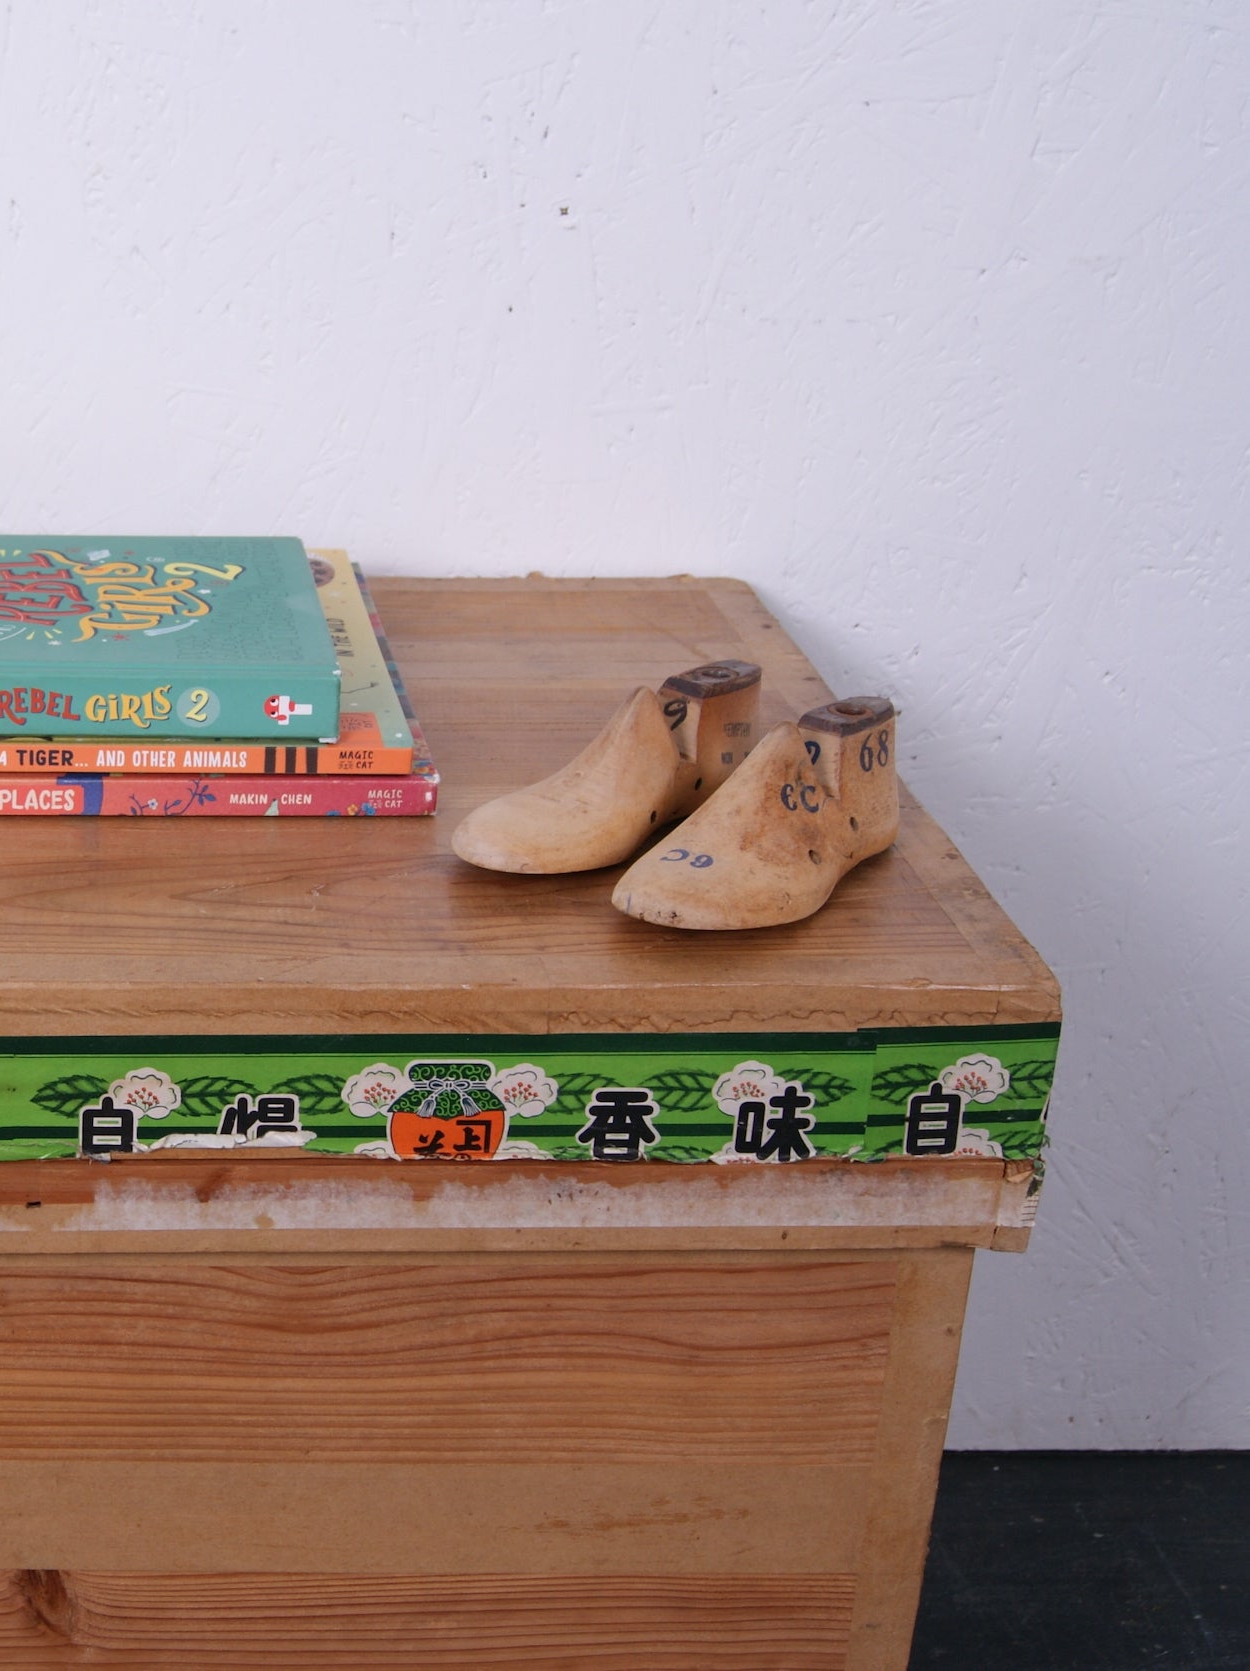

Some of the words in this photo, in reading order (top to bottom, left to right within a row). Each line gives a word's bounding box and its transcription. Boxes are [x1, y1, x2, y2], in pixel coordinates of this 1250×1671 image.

[164, 562, 244, 580] 2
[186, 689, 210, 722] 2
[339, 750, 374, 760] MAGIC
[859, 729, 890, 773] 68
[96, 750, 126, 768] AND
[132, 750, 176, 768] OTHER
[183, 751, 248, 768] ANIMALS
[356, 761, 374, 769] CAT
[229, 793, 268, 805] MAKIN
[281, 793, 312, 805] CHEN
[367, 789, 403, 799] MAGIC
[384, 800, 403, 808] CAT
